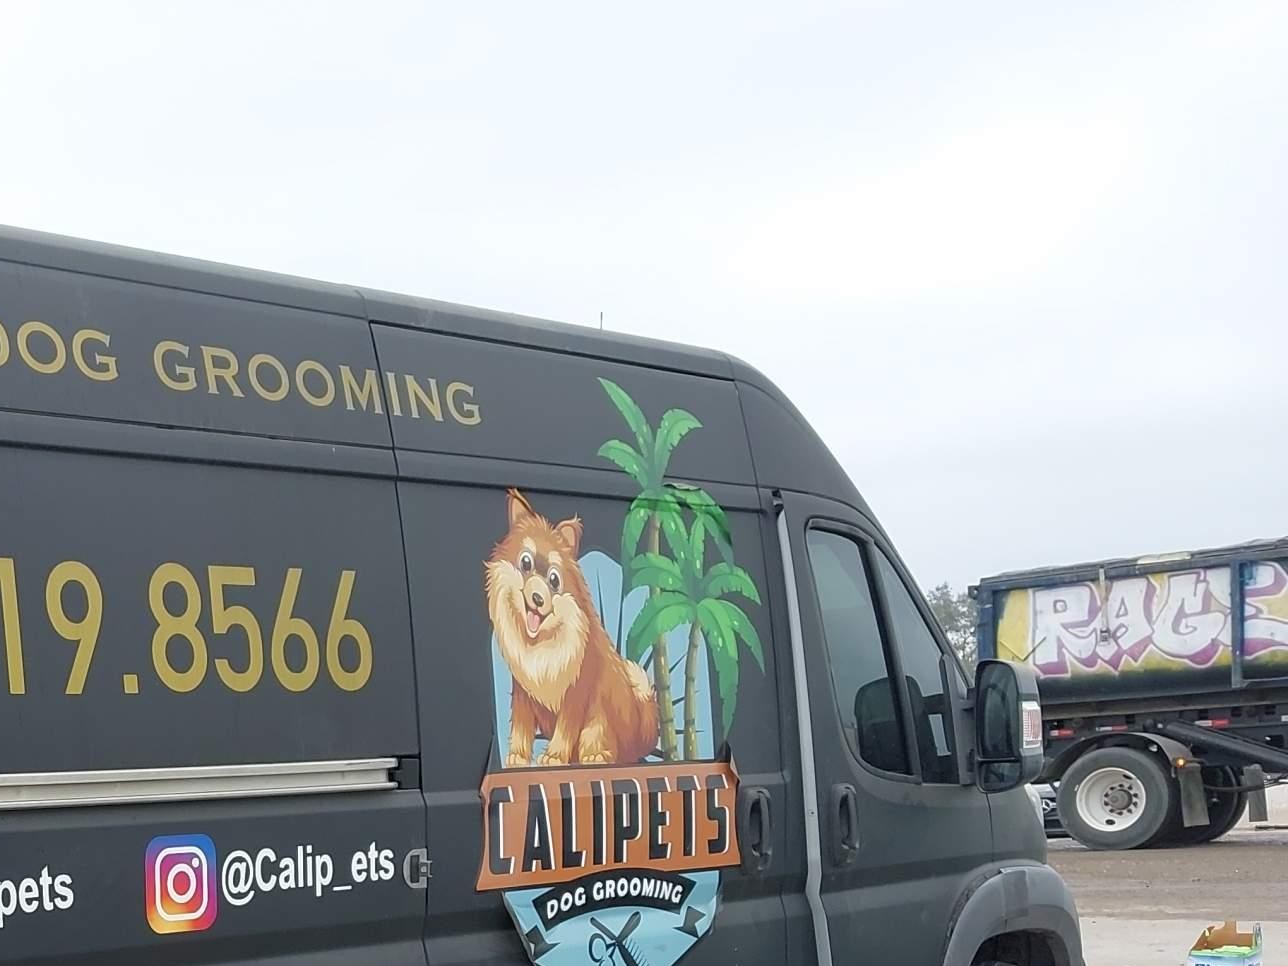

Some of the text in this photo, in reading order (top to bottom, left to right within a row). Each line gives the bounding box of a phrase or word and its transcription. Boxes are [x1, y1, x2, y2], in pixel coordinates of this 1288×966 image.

[152, 340, 482, 426] GROOMING
[488, 773, 731, 876] CALIPETS
[221, 841, 395, 907] @Calip_ets
[546, 877, 684, 920] DOG GROOMING
